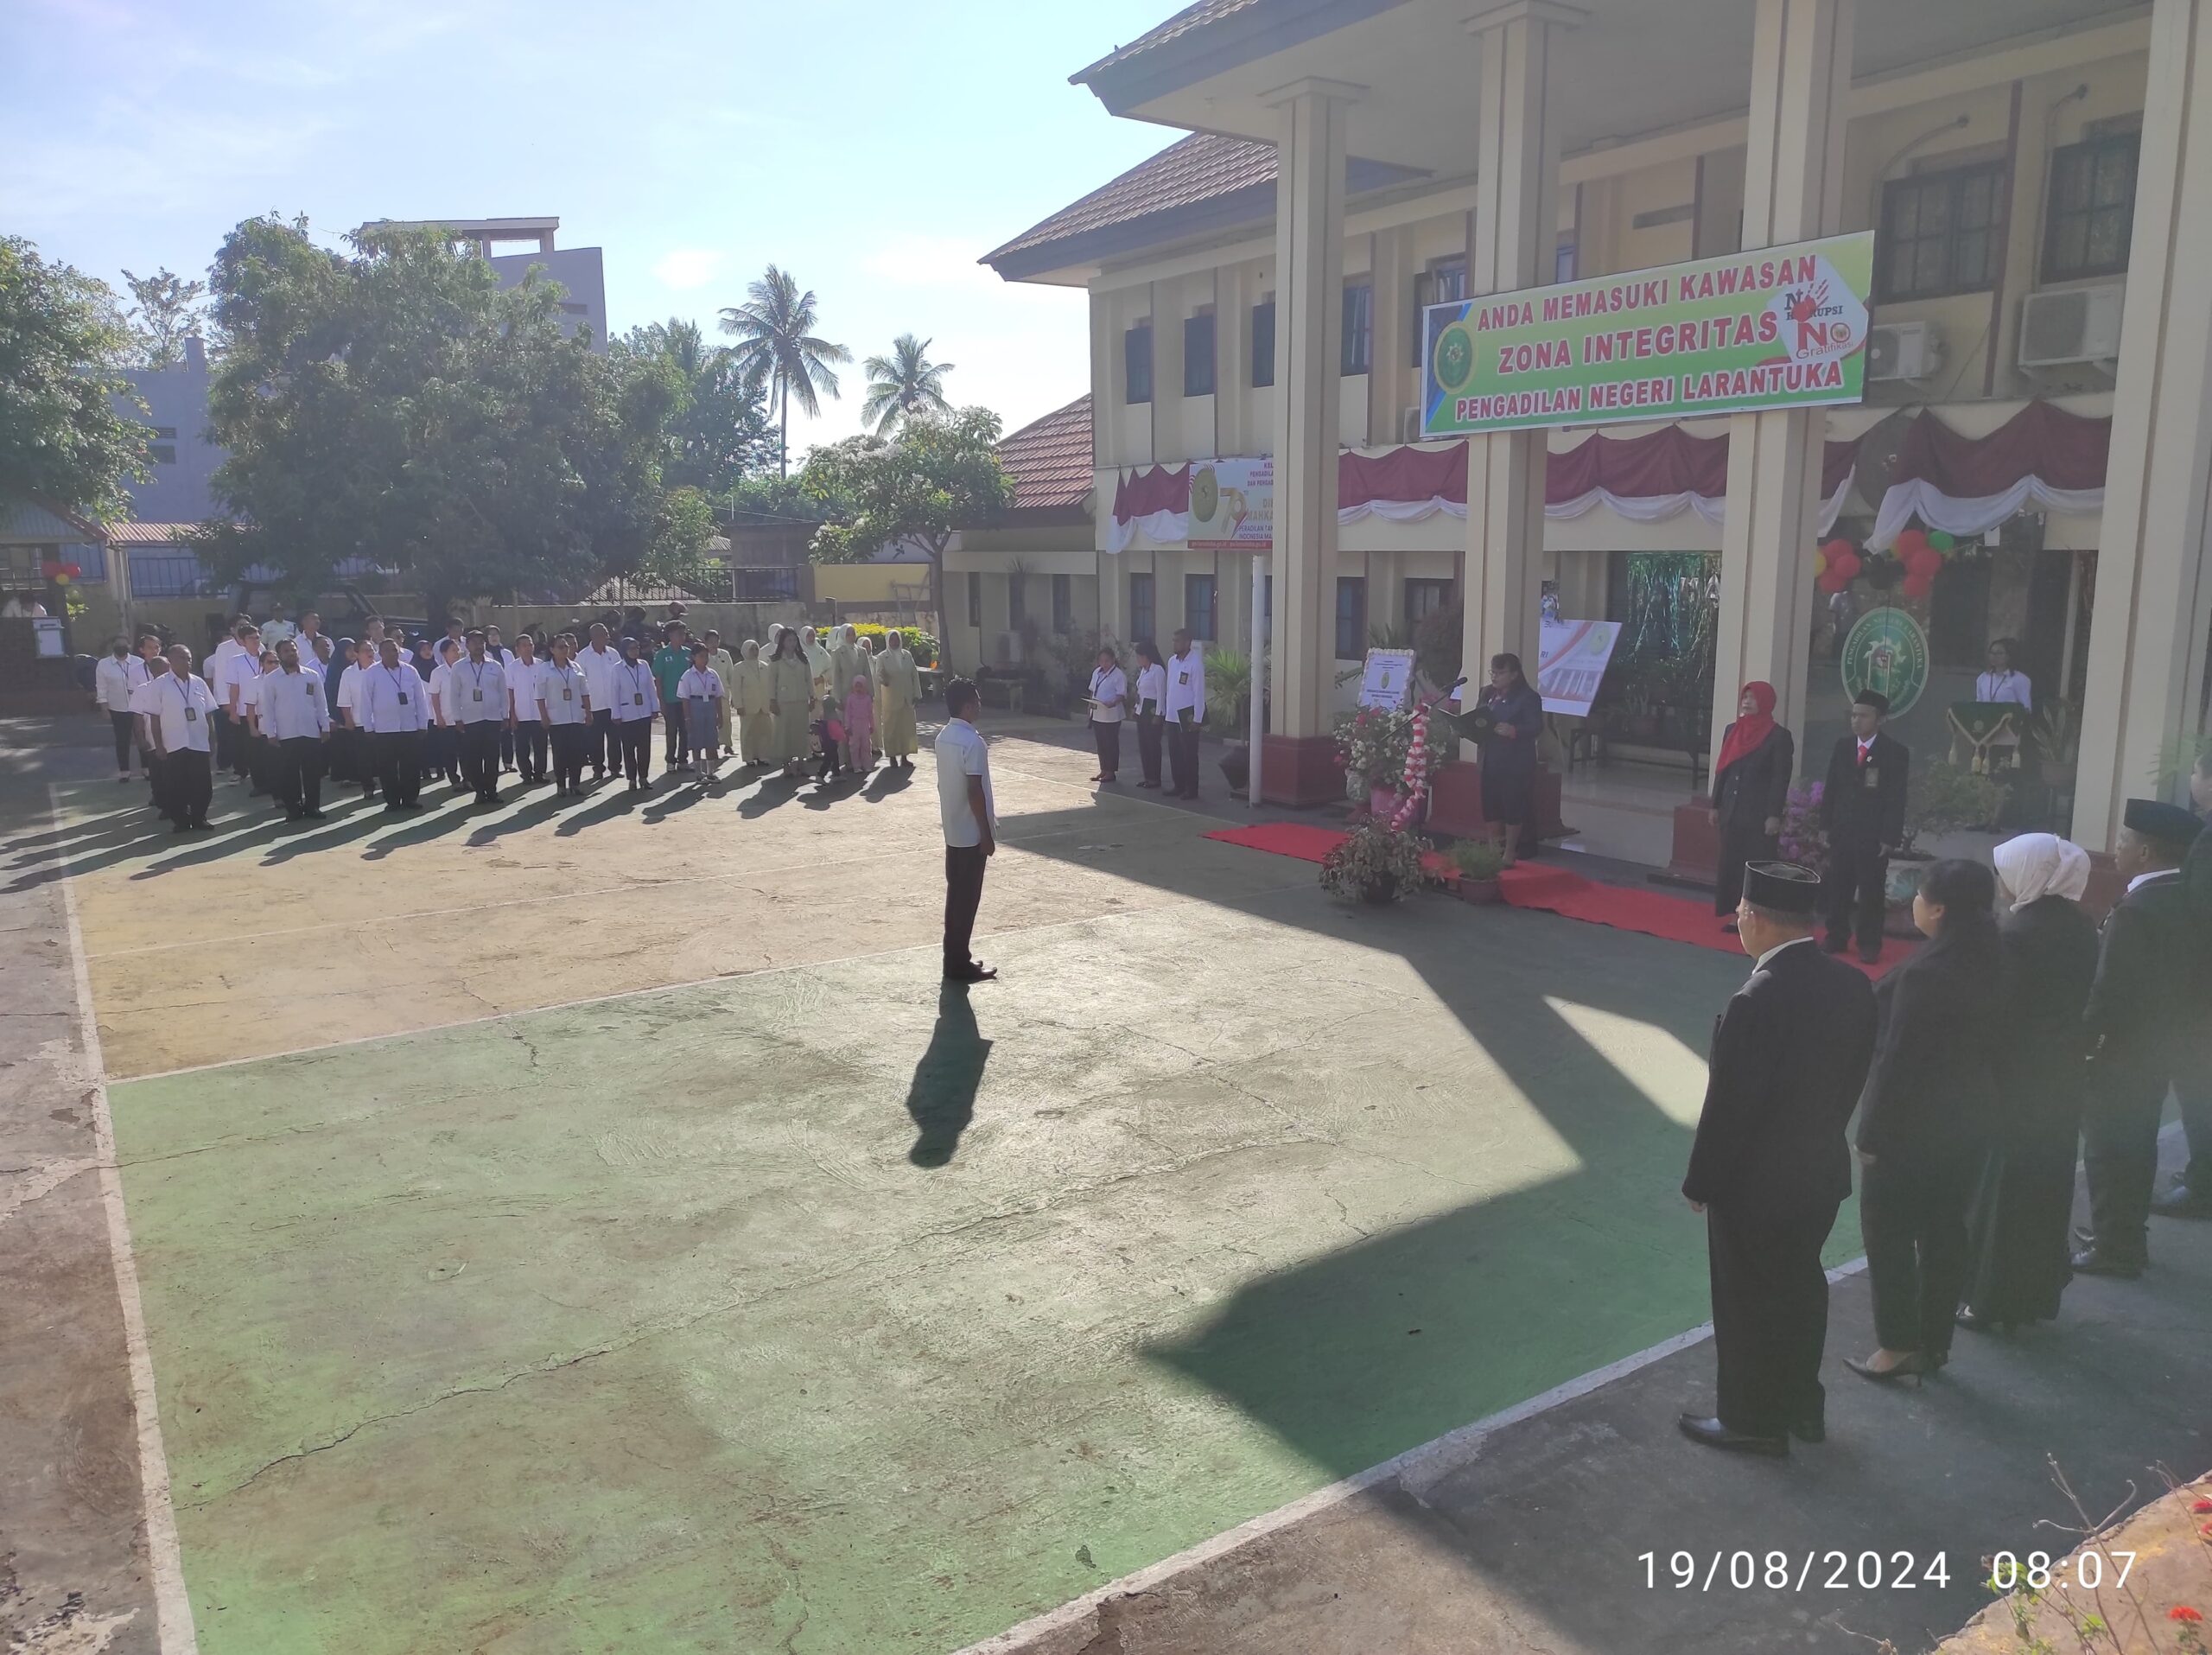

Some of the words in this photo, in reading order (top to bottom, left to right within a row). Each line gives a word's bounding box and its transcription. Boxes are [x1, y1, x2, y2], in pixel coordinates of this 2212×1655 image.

[1478, 301, 1534, 331] ANDA
[1543, 280, 1669, 321] MEMASUKI
[1680, 254, 1816, 302] KAWASAN
[1498, 341, 1572, 374] ZONA
[1584, 311, 1777, 363] INTEGRITAS
[1796, 341, 1853, 360] Gratifikasi
[1457, 387, 1581, 421] PENGADILAN
[1590, 379, 1673, 408] NEGERI
[1683, 361, 1842, 399] LARANTUKA
